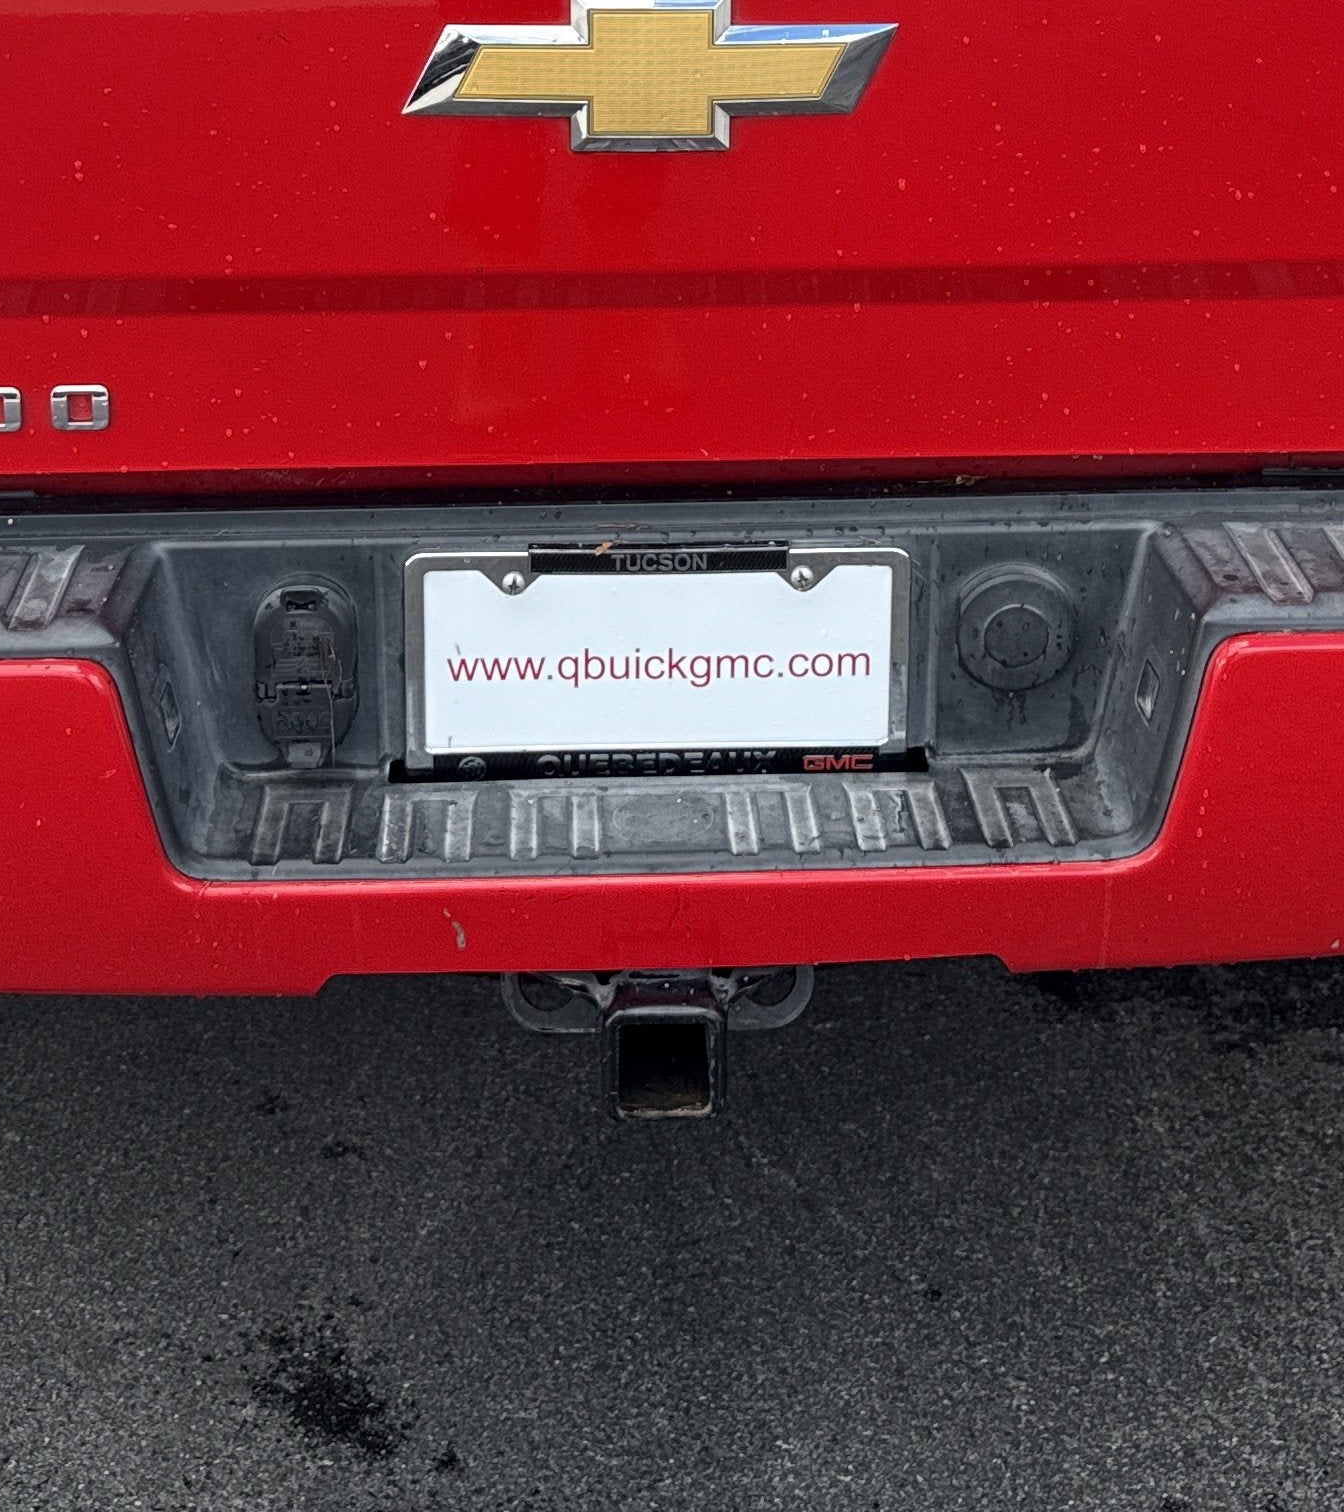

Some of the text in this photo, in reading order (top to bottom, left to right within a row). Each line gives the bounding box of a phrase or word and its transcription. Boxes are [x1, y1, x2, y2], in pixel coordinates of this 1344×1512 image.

[610, 552, 708, 572] TUCSON
[447, 648, 871, 688] www.qbuickgmc.com
[536, 750, 874, 777] QUEBEDEAUX GMC
